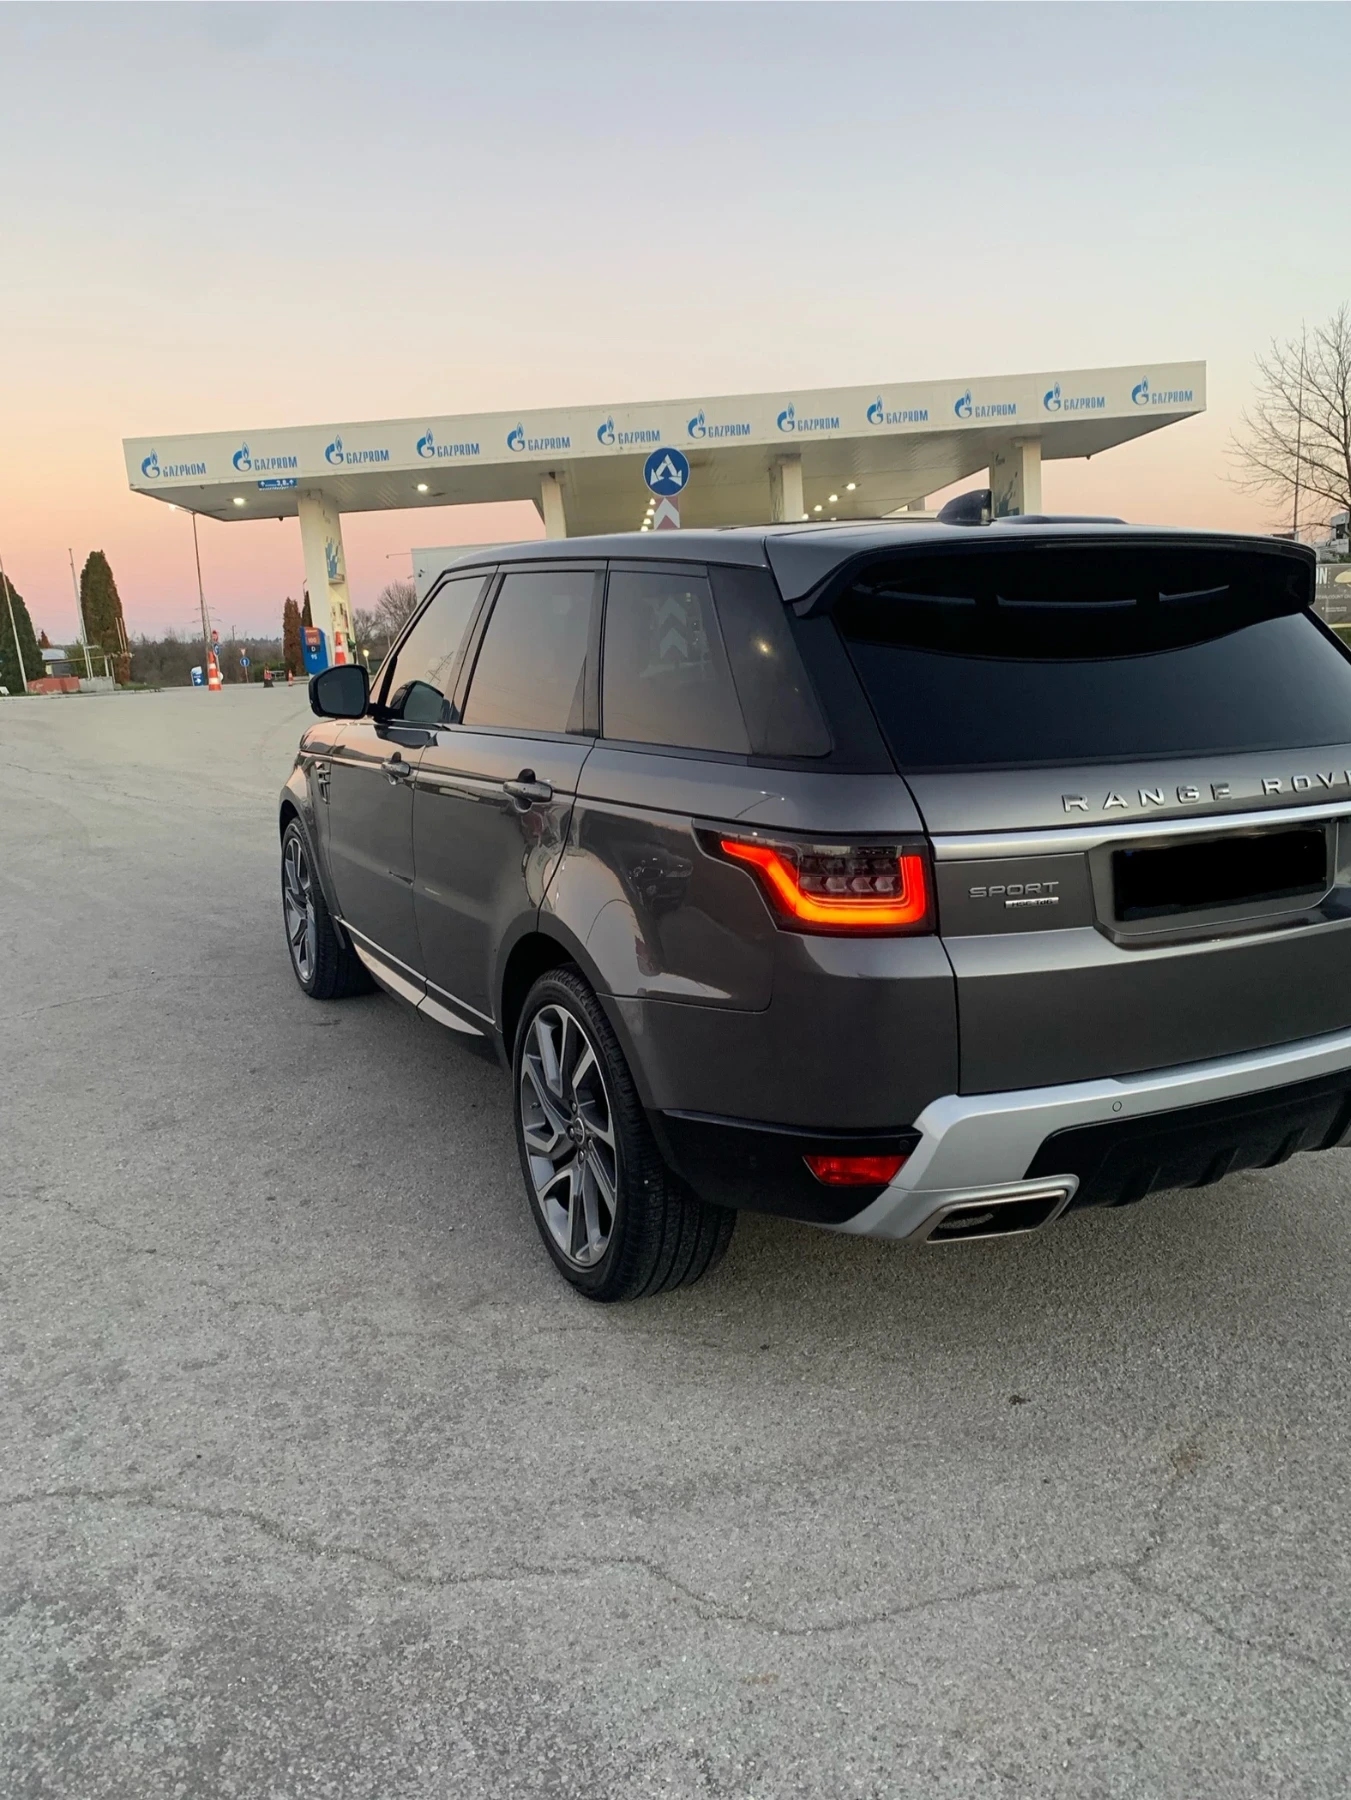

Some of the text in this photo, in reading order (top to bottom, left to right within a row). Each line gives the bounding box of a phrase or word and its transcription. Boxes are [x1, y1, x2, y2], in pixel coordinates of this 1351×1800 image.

[1064, 396, 1106, 410] GAZPROM
[1151, 389, 1194, 404] GAZPROM
[887, 408, 929, 423] GAZPROM
[975, 403, 1018, 417] GAZPROM
[709, 423, 752, 438] GAZPROM
[798, 416, 841, 431] GAZPROM
[528, 436, 571, 451] GAZPROM
[617, 429, 660, 445] GAZPROM
[346, 448, 391, 464] GAZPROM
[438, 442, 480, 457] GAZPROM
[255, 455, 298, 471] GAZPROM
[1061, 782, 1233, 813] RANGE
[968, 881, 1060, 898] SPORT
